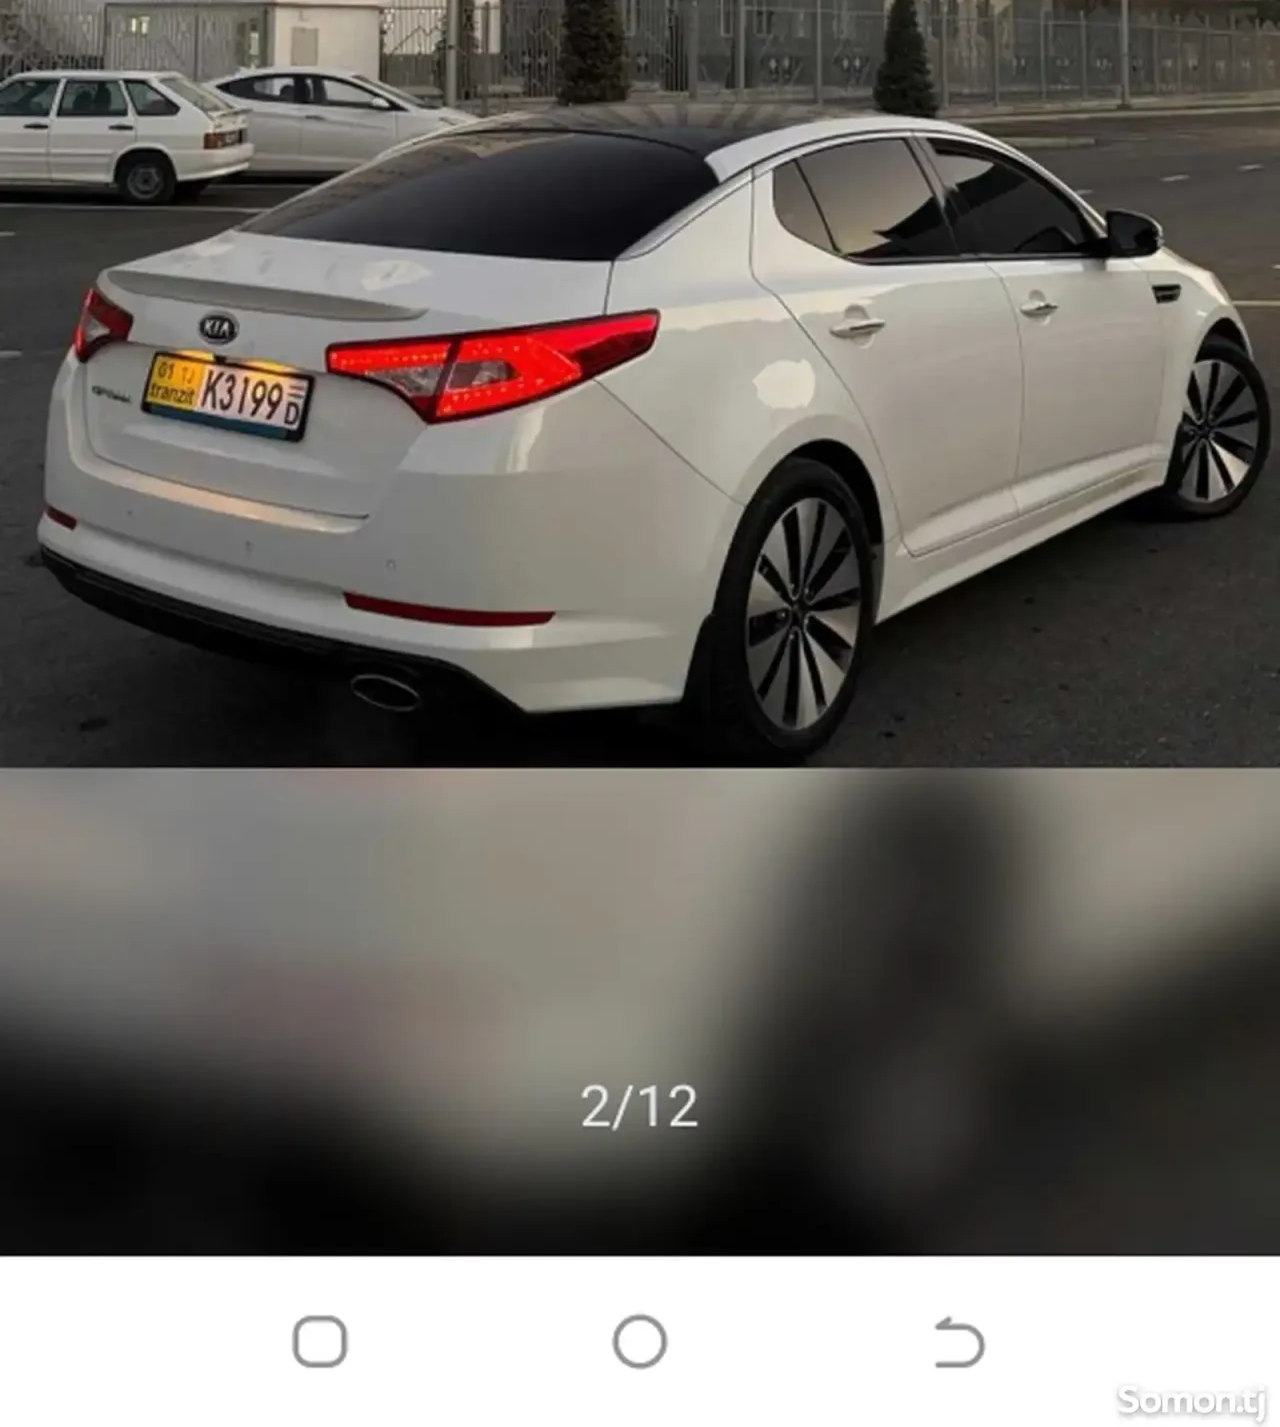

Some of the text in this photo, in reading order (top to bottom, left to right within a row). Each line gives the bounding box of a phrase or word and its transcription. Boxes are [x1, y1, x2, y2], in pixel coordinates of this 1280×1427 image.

[203, 319, 230, 335] KIA
[158, 361, 175, 380] 01
[150, 383, 195, 406] tranzit
[201, 369, 283, 421] K3199
[284, 401, 300, 425] D
